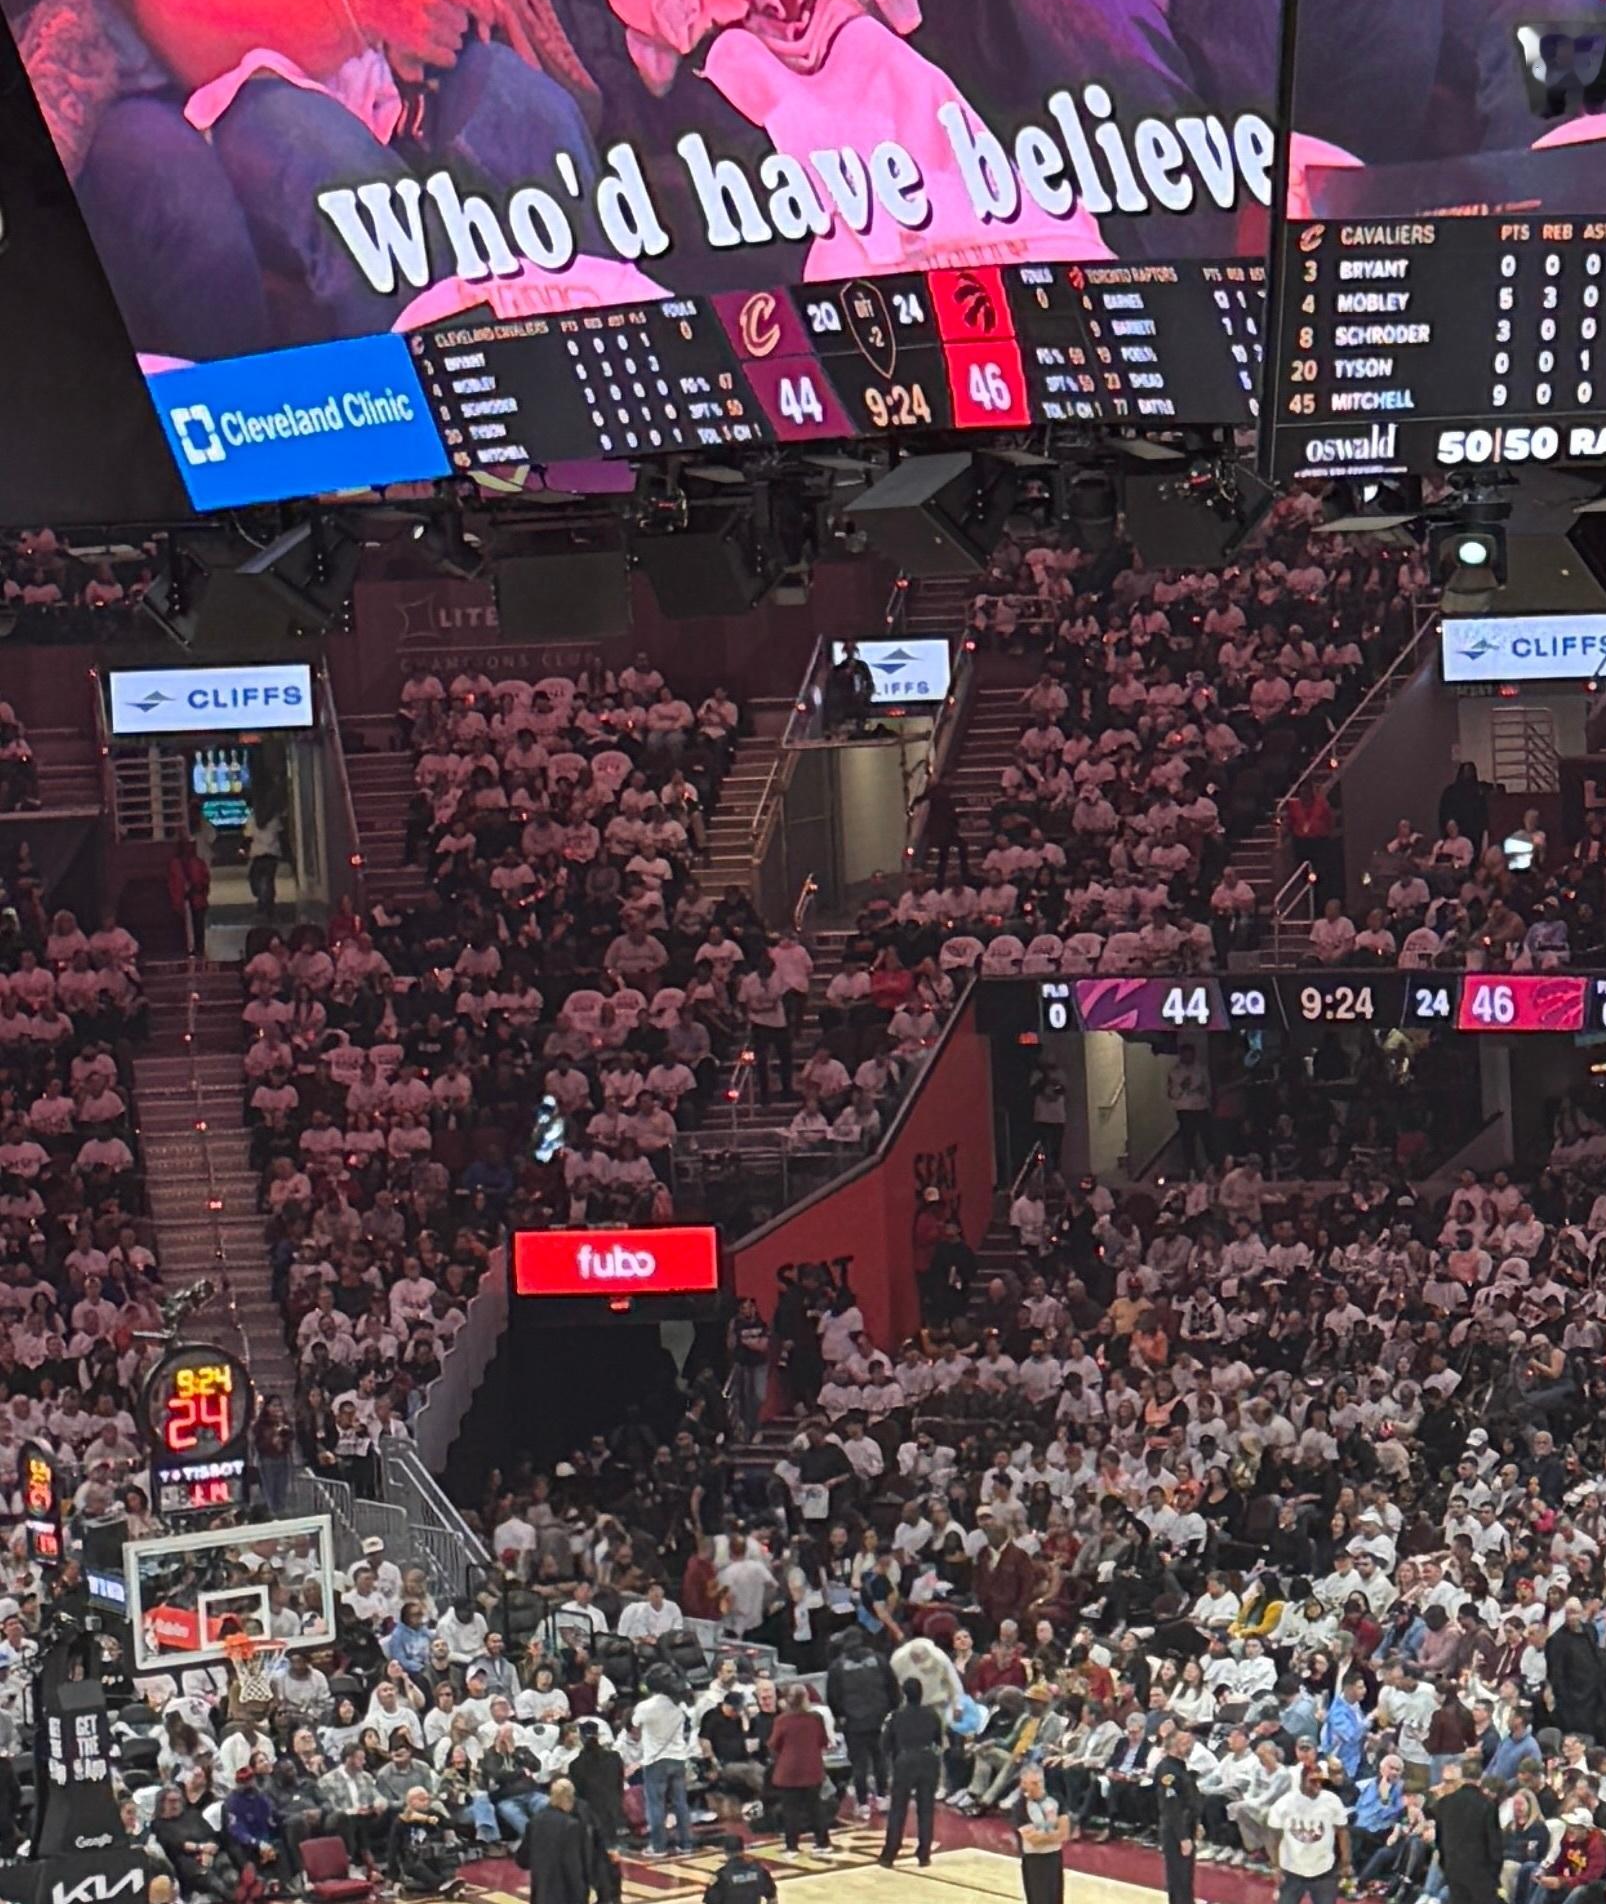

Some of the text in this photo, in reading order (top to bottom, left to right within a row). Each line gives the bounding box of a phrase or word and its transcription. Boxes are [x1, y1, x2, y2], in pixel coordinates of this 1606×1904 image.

[318, 142, 670, 294] Who'd
[677, 132, 923, 247] have
[1341, 225, 1435, 245] CAVALIERS
[1500, 224, 1530, 241] PTS
[1543, 223, 1573, 240] REB
[1304, 260, 1318, 282] 3
[1340, 259, 1409, 280] BRYANT
[893, 294, 924, 324] 24
[1302, 294, 1315, 314] 4
[1338, 292, 1410, 313] MOBLEY
[1299, 327, 1313, 349] 8
[968, 362, 1012, 412] 46
[1291, 360, 1318, 381] 20
[1335, 358, 1393, 378] TYSON
[779, 376, 823, 424] 44
[865, 384, 932, 427] 9:24
[1289, 393, 1315, 415] 45
[1331, 390, 1415, 412] MITCHELL
[221, 394, 343, 447] Cleveland
[343, 389, 414, 429] Clinic
[1306, 424, 1398, 463] oswald
[188, 686, 303, 710] CLIFFS
[1049, 985, 1514, 1029] 0 44 2Q 9:24 24 46
[577, 1244, 655, 1279] fubo
[169, 1396, 229, 1449] 24
